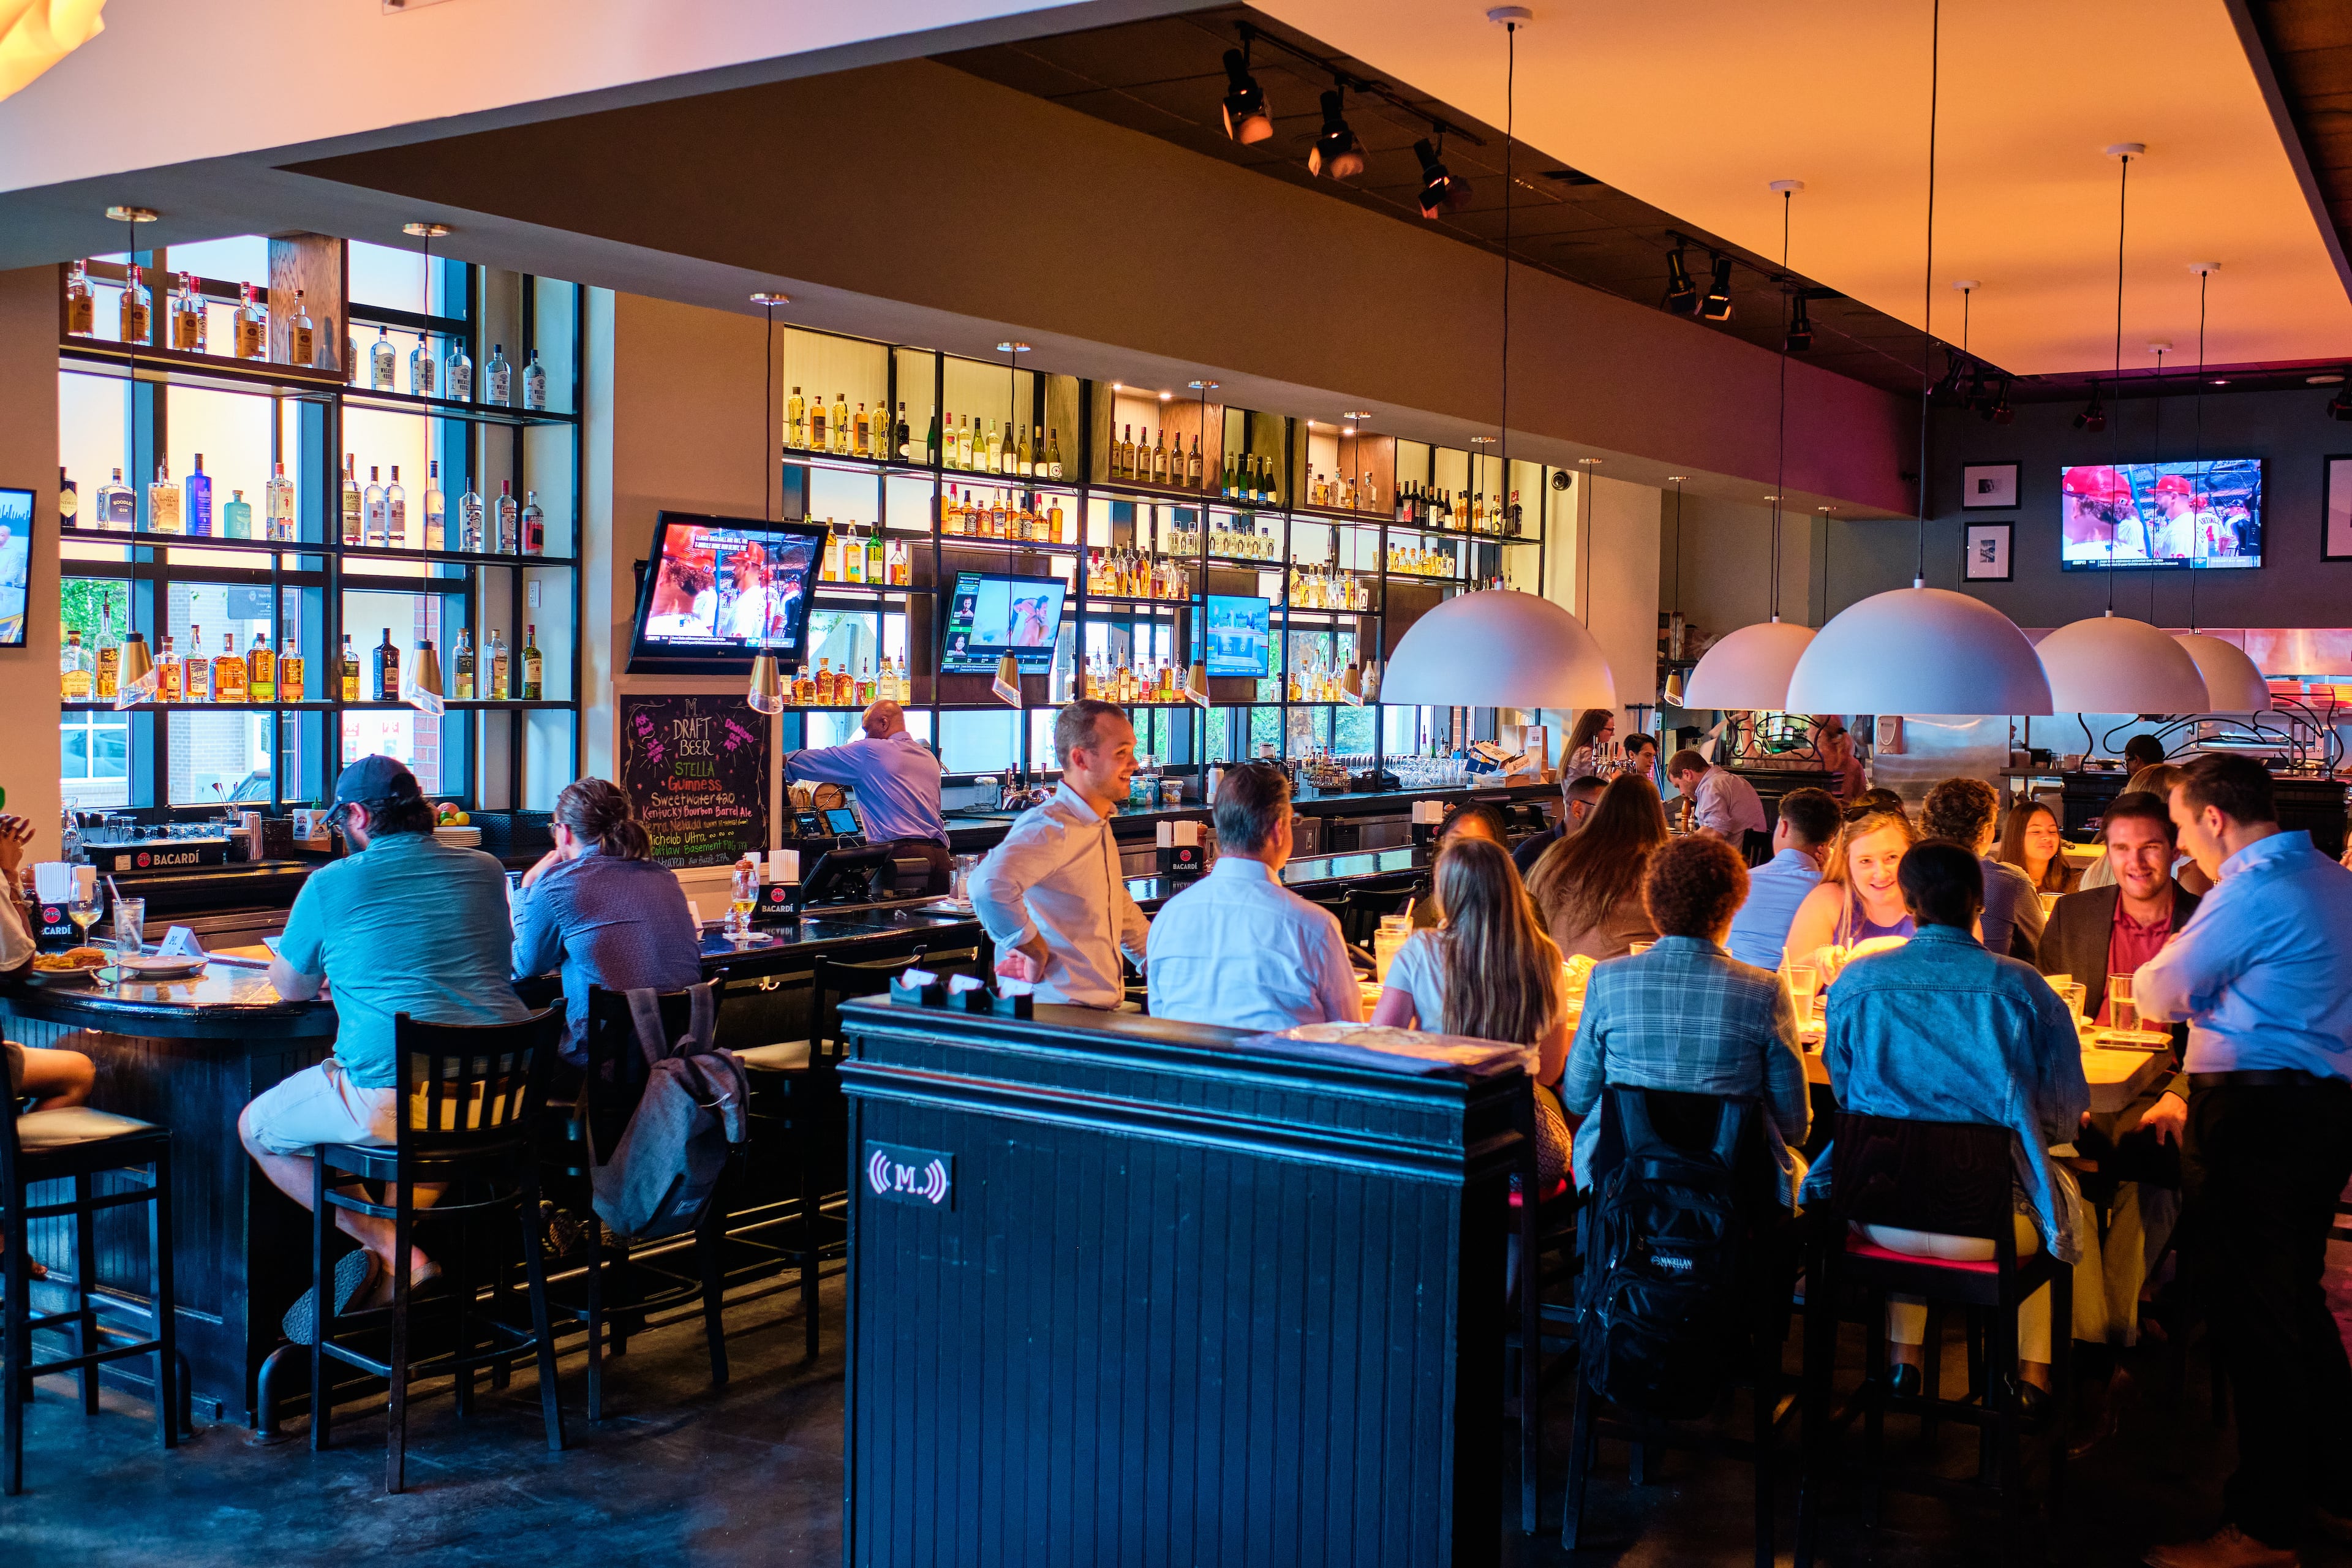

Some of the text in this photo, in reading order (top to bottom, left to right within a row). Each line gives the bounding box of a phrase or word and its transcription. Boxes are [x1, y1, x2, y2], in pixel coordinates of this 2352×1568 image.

[673, 717, 712, 740] DRAFT
[680, 739, 714, 756] BEER
[675, 761, 715, 777] STELLA
[668, 775, 723, 793] Guinness
[643, 805, 753, 821] Kentucky Bourbon Barrel Ale
[684, 831, 707, 844] Ultra
[684, 840, 722, 854] Basement
[154, 849, 200, 865] BACARDÍ
[762, 903, 794, 913] BACARDÍ
[42, 924, 72, 935] CARDÍ
[1660, 1256, 1693, 1268] MAGELLAN
